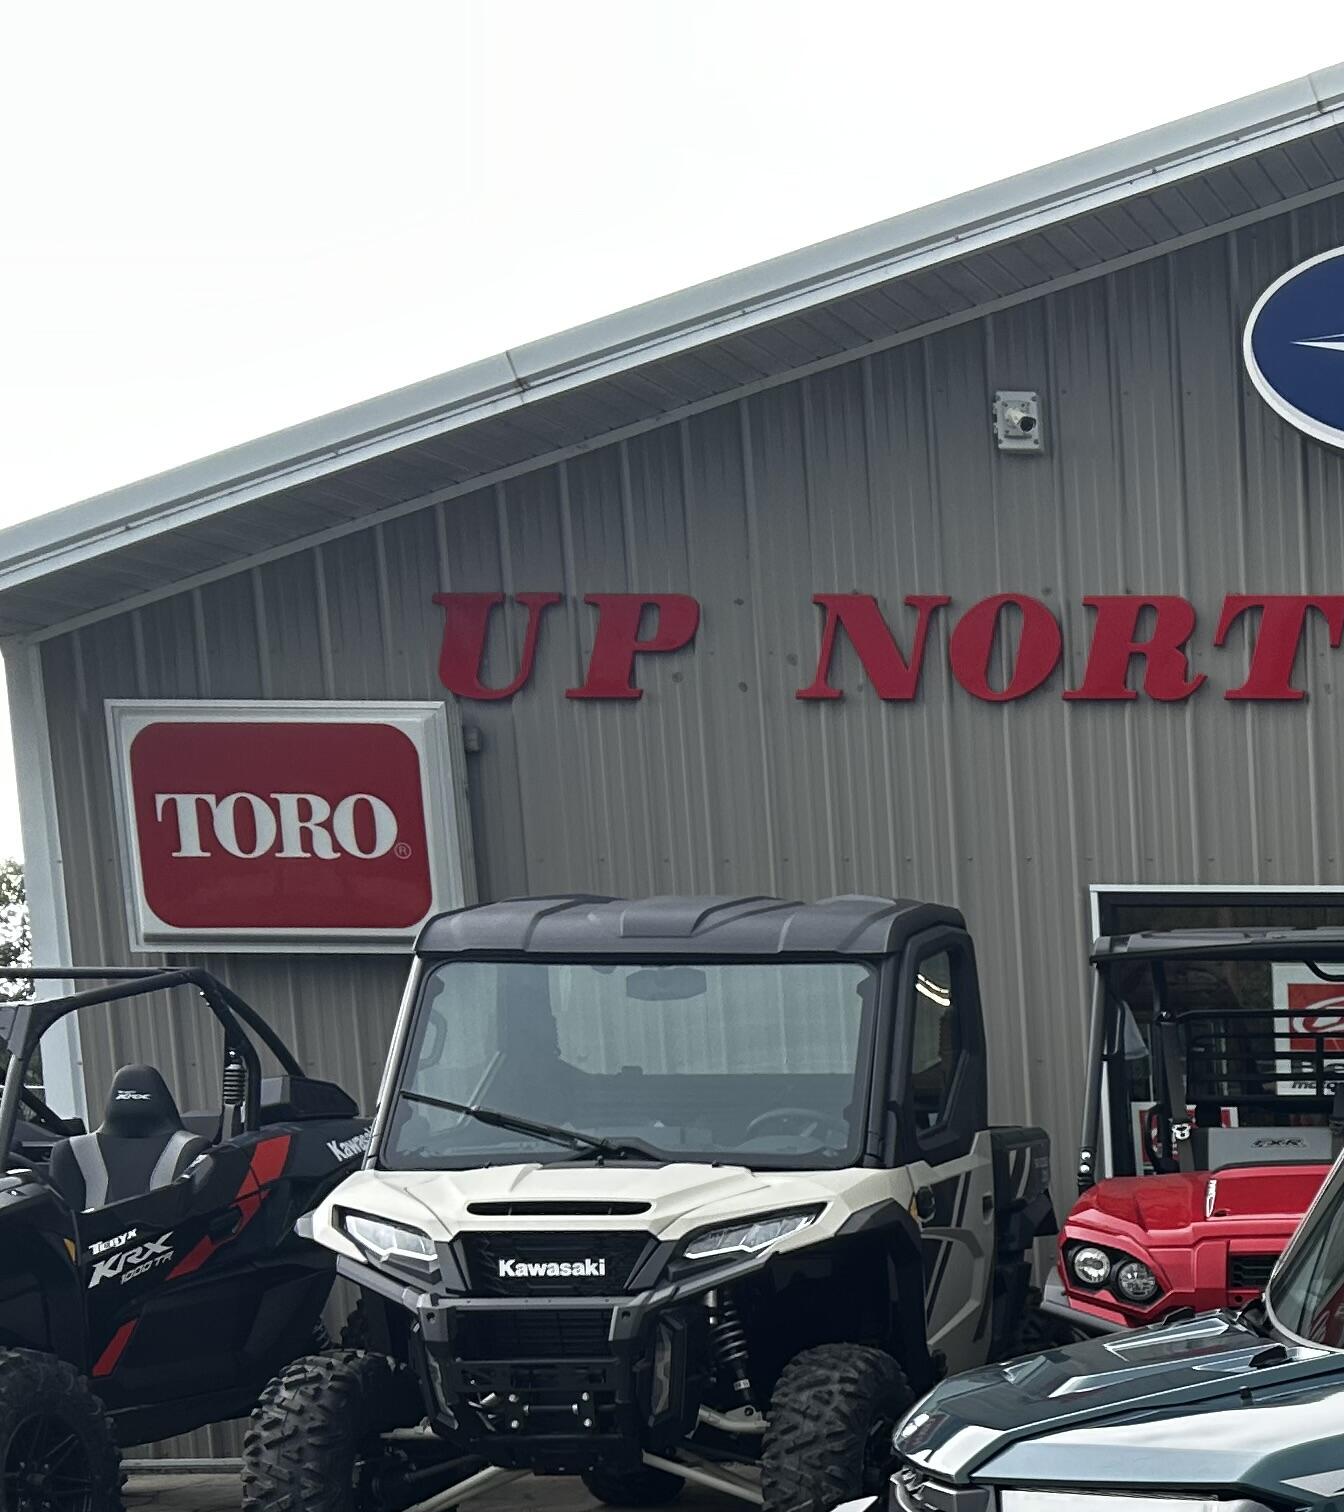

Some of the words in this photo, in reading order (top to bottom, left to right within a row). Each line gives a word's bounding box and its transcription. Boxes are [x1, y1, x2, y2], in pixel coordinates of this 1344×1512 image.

[432, 591, 701, 702] UP
[155, 791, 399, 861] TORO
[88, 1230, 174, 1289] KRX
[499, 1258, 606, 1277] Kawasaki
